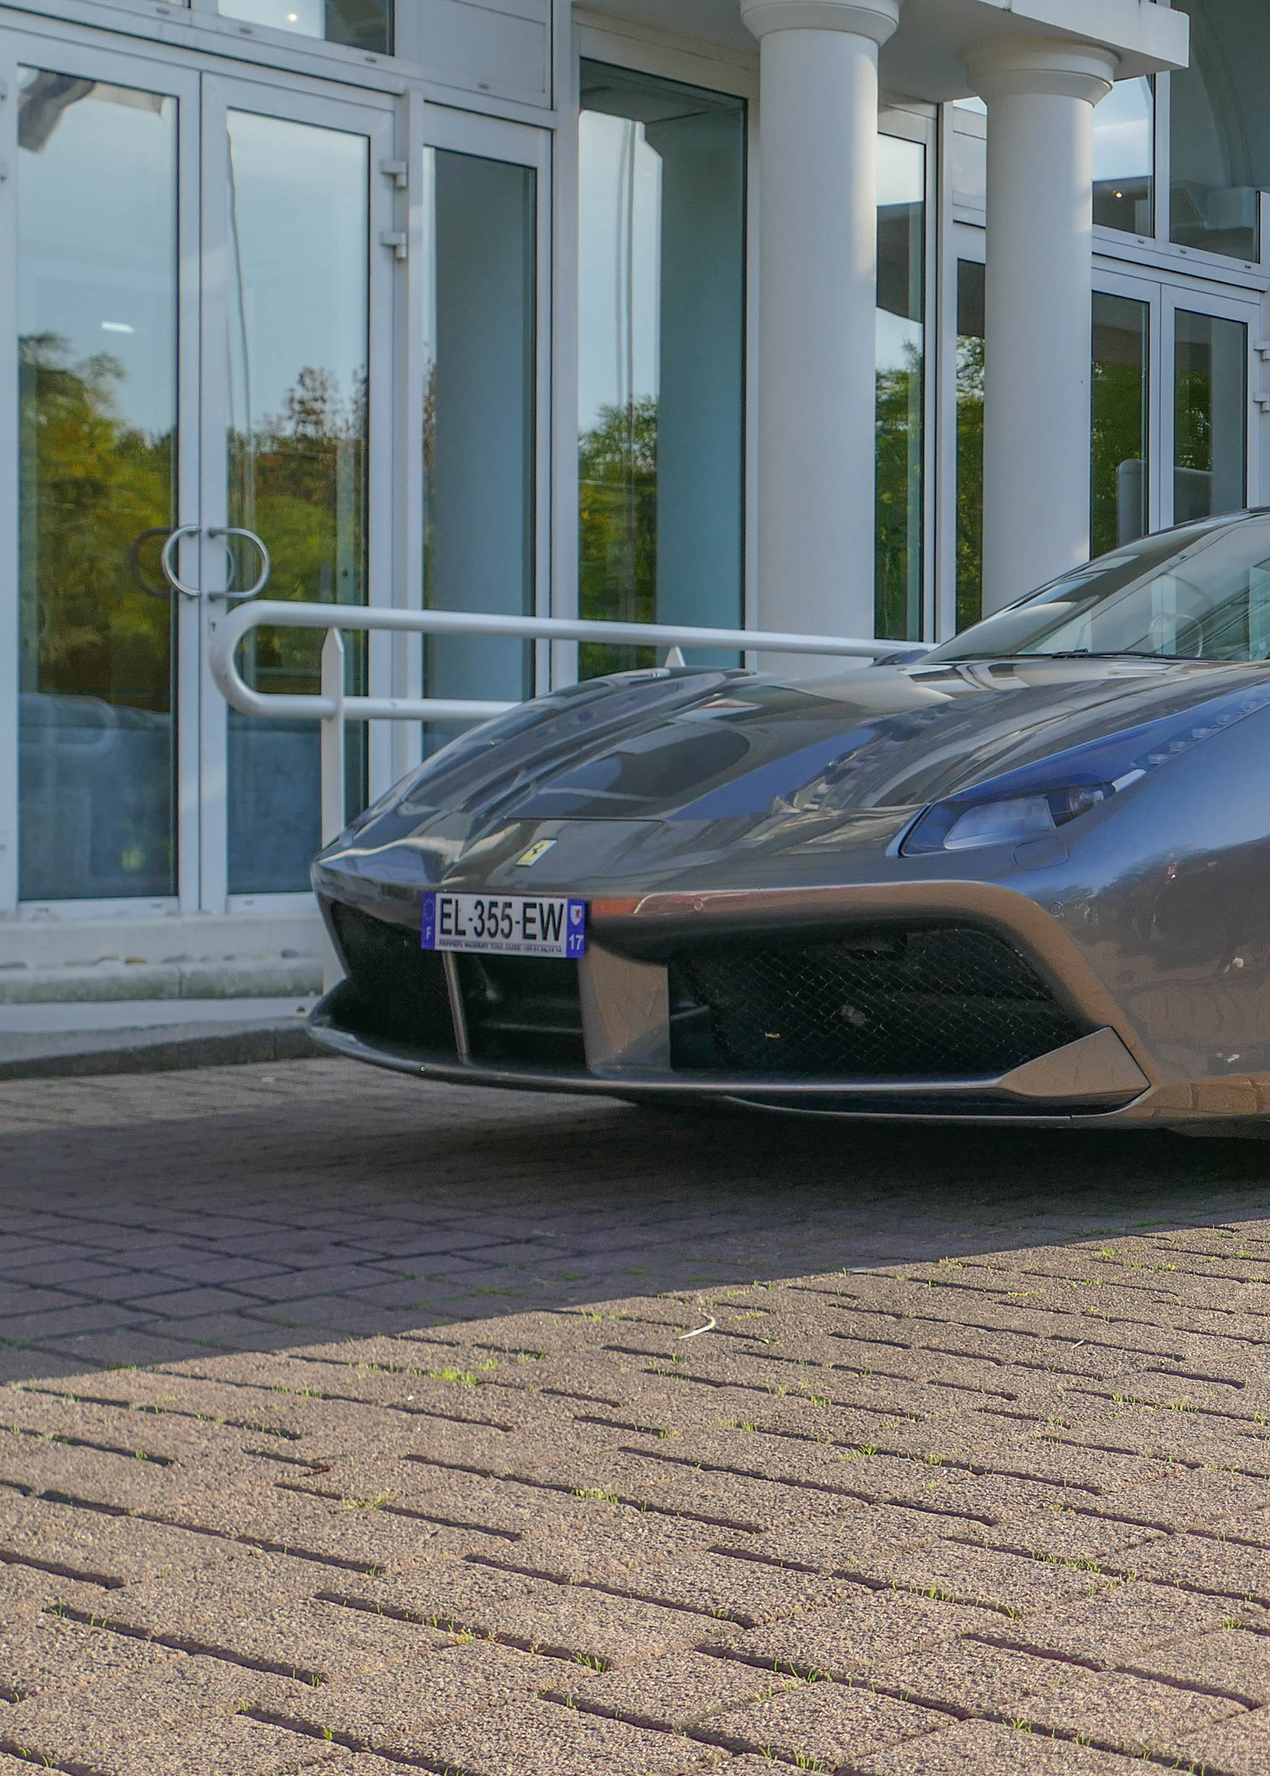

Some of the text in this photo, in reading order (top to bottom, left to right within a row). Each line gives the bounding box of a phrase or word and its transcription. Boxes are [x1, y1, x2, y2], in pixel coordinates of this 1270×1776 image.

[439, 898, 564, 941] EL-355-EW
[426, 927, 431, 940] F
[569, 935, 584, 950] 17
